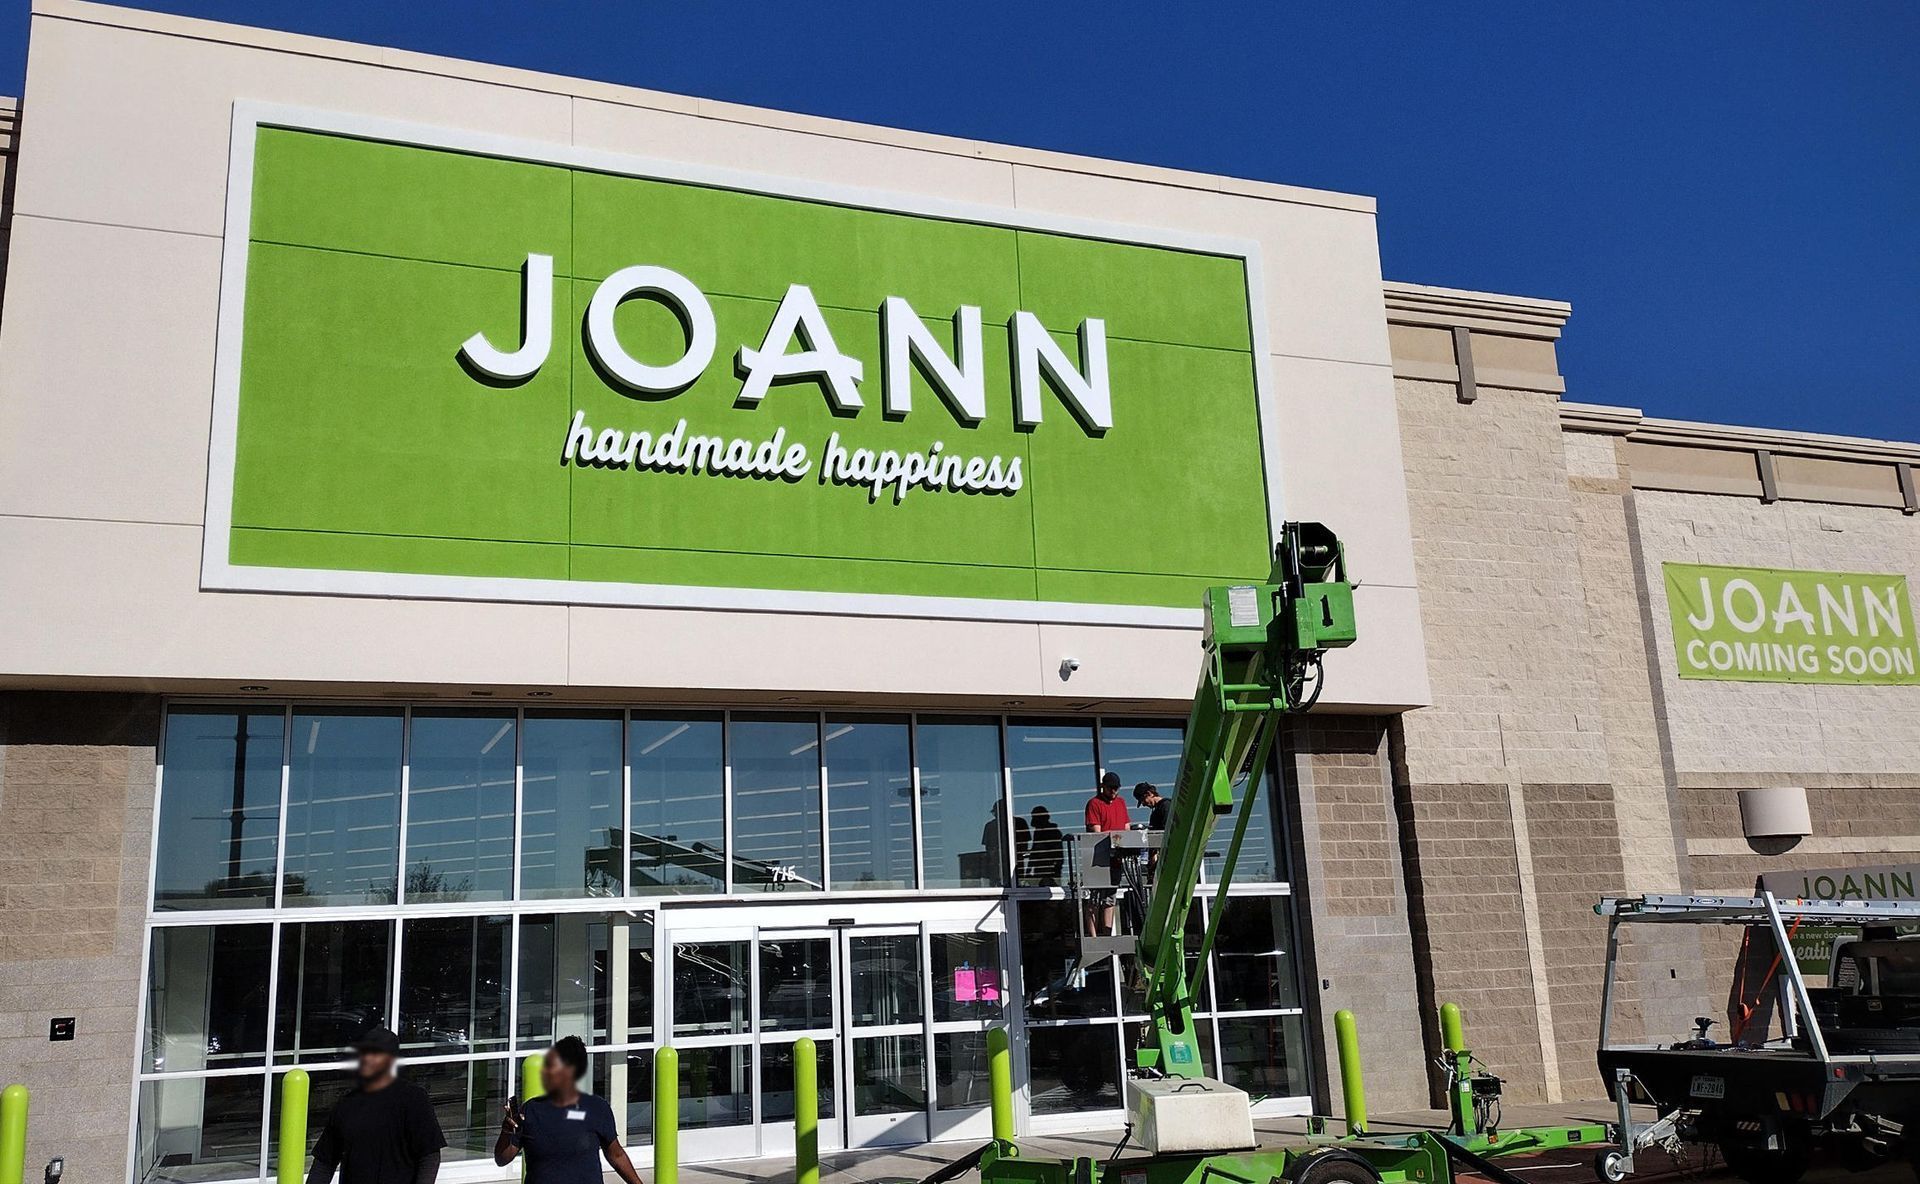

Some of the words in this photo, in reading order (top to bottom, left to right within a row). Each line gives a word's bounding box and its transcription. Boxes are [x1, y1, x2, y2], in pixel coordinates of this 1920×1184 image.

[458, 253, 1113, 434] JOANN
[564, 410, 812, 479] handmade
[821, 432, 1024, 501] happiness
[1320, 595, 1334, 627] 1
[1687, 577, 1904, 637] JOANN
[1686, 639, 1820, 674] COMING
[1826, 645, 1915, 675] SOON
[772, 865, 796, 881] 715
[1797, 872, 1915, 900] JOANN
